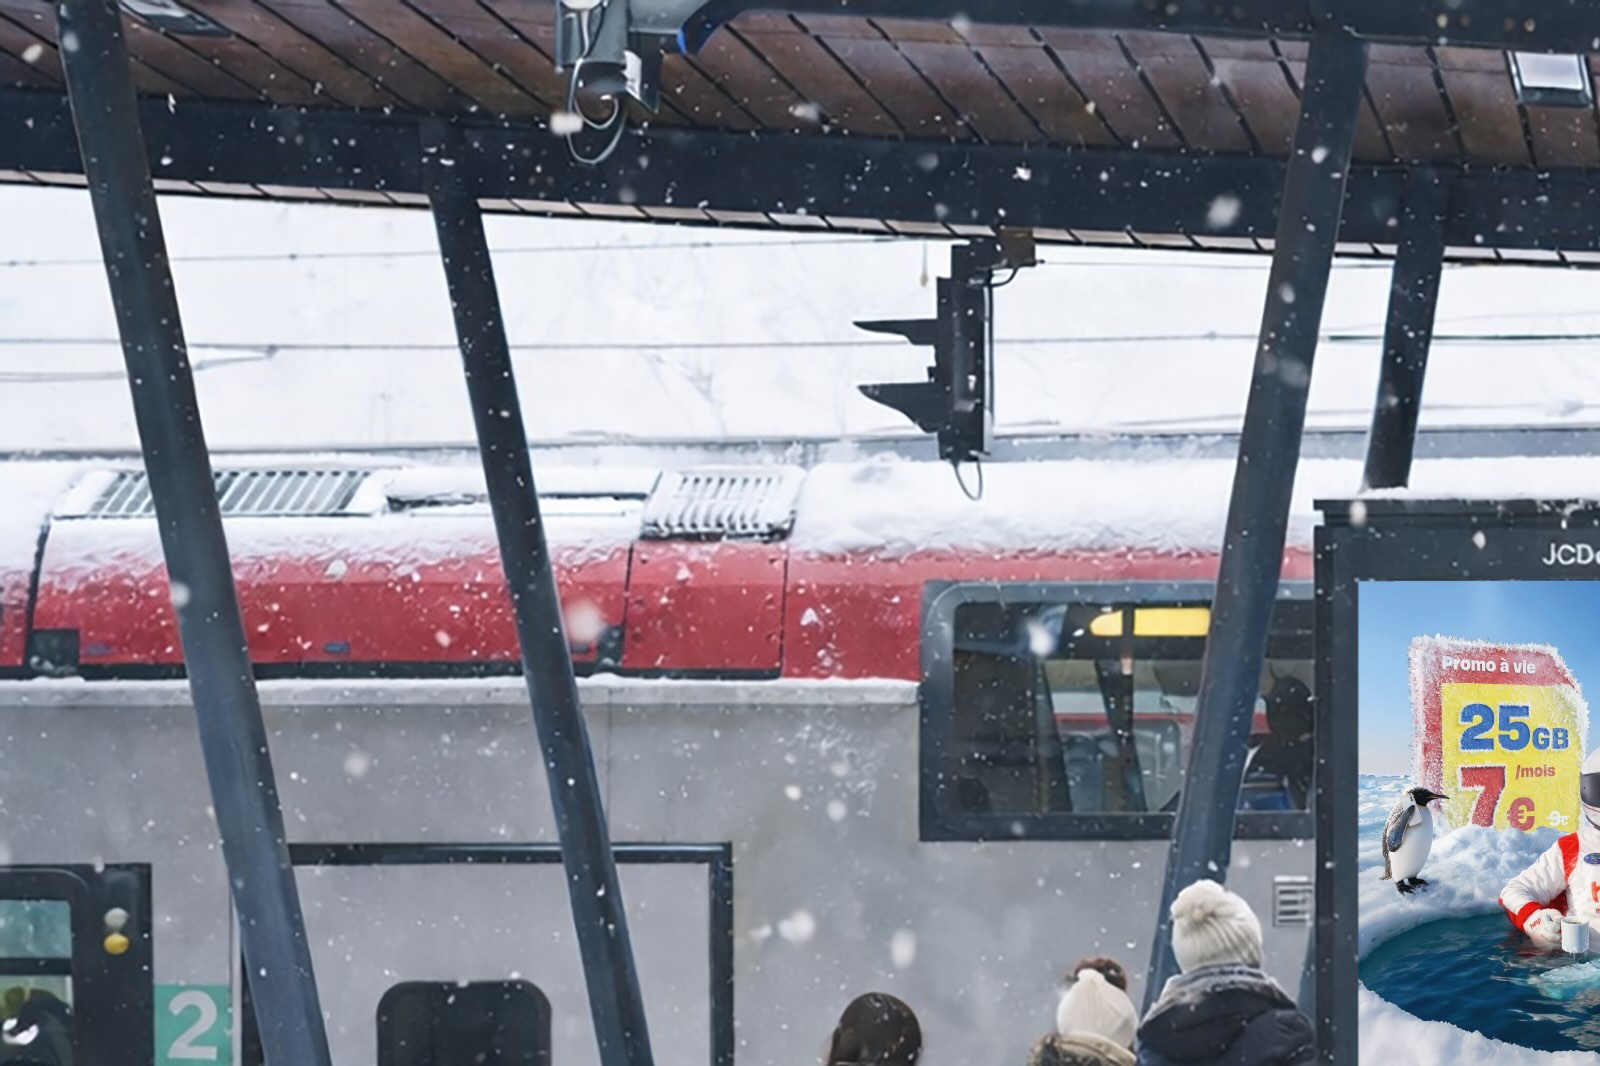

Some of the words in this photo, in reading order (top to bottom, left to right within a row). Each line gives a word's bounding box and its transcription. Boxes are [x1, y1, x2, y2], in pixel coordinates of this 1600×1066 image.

[1443, 657, 1496, 672] Promo
[1500, 658, 1509, 673] à
[1513, 661, 1536, 674] vie
[167, 990, 217, 1060] 2
